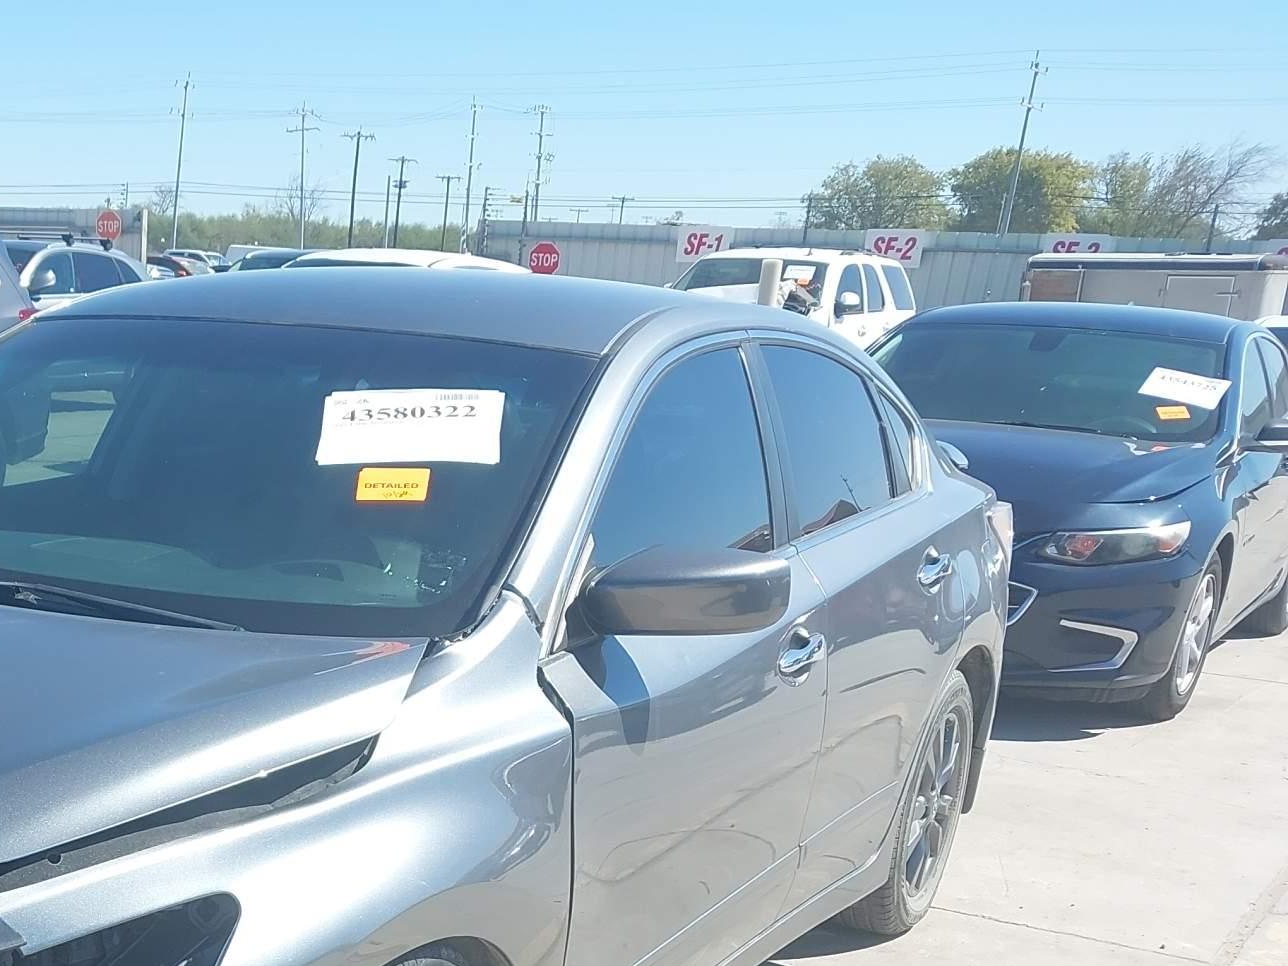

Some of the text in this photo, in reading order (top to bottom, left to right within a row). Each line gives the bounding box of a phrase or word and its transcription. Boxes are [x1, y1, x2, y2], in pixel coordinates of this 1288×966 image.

[98, 220, 120, 233] STOP
[683, 233, 724, 256] SF-1
[873, 236, 918, 260] SF-2
[531, 252, 558, 267] STOP
[341, 404, 478, 422] 43580322
